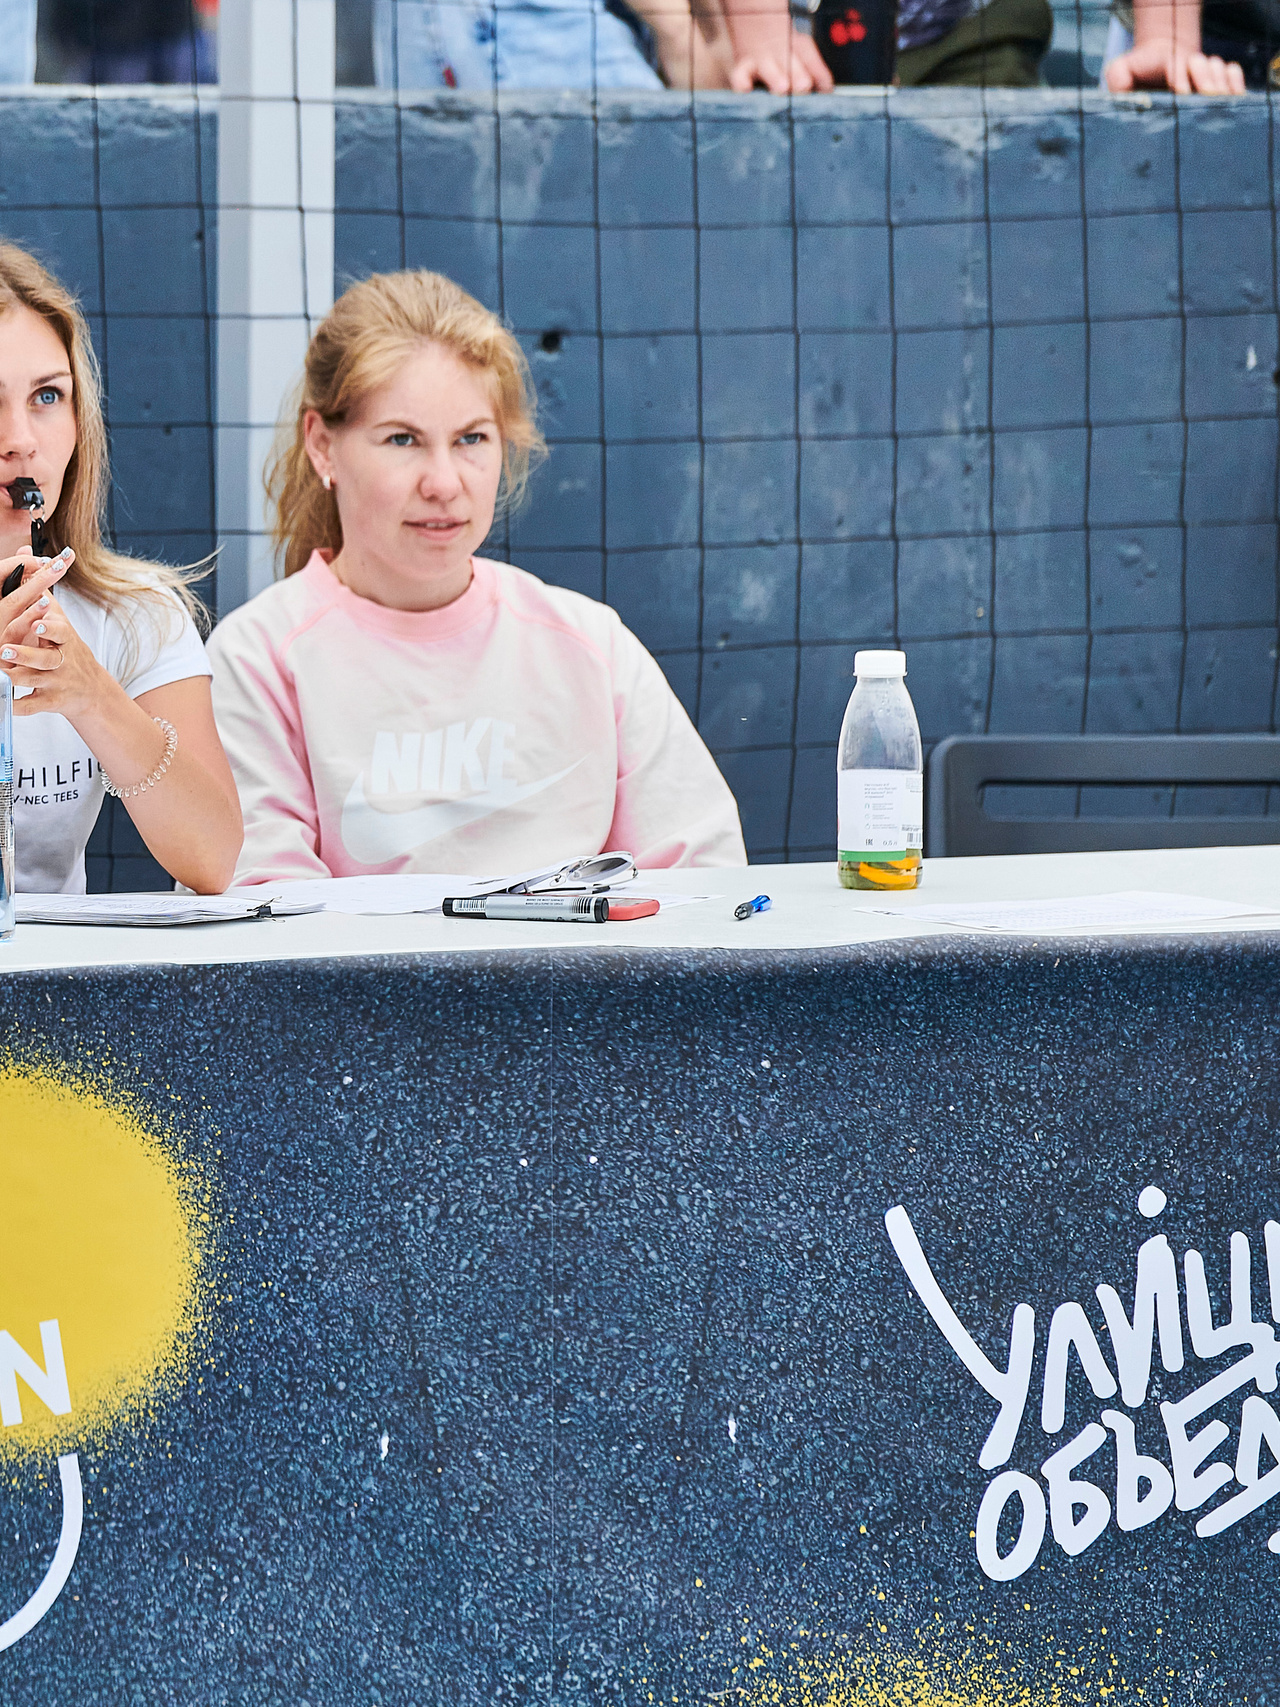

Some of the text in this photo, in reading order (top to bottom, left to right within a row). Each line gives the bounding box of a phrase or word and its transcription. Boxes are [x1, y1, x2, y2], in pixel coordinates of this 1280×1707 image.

[53, 789, 79, 803] TEES
[371, 717, 520, 796] NIKE
[884, 1186, 1280, 1471] УЛИЦ
